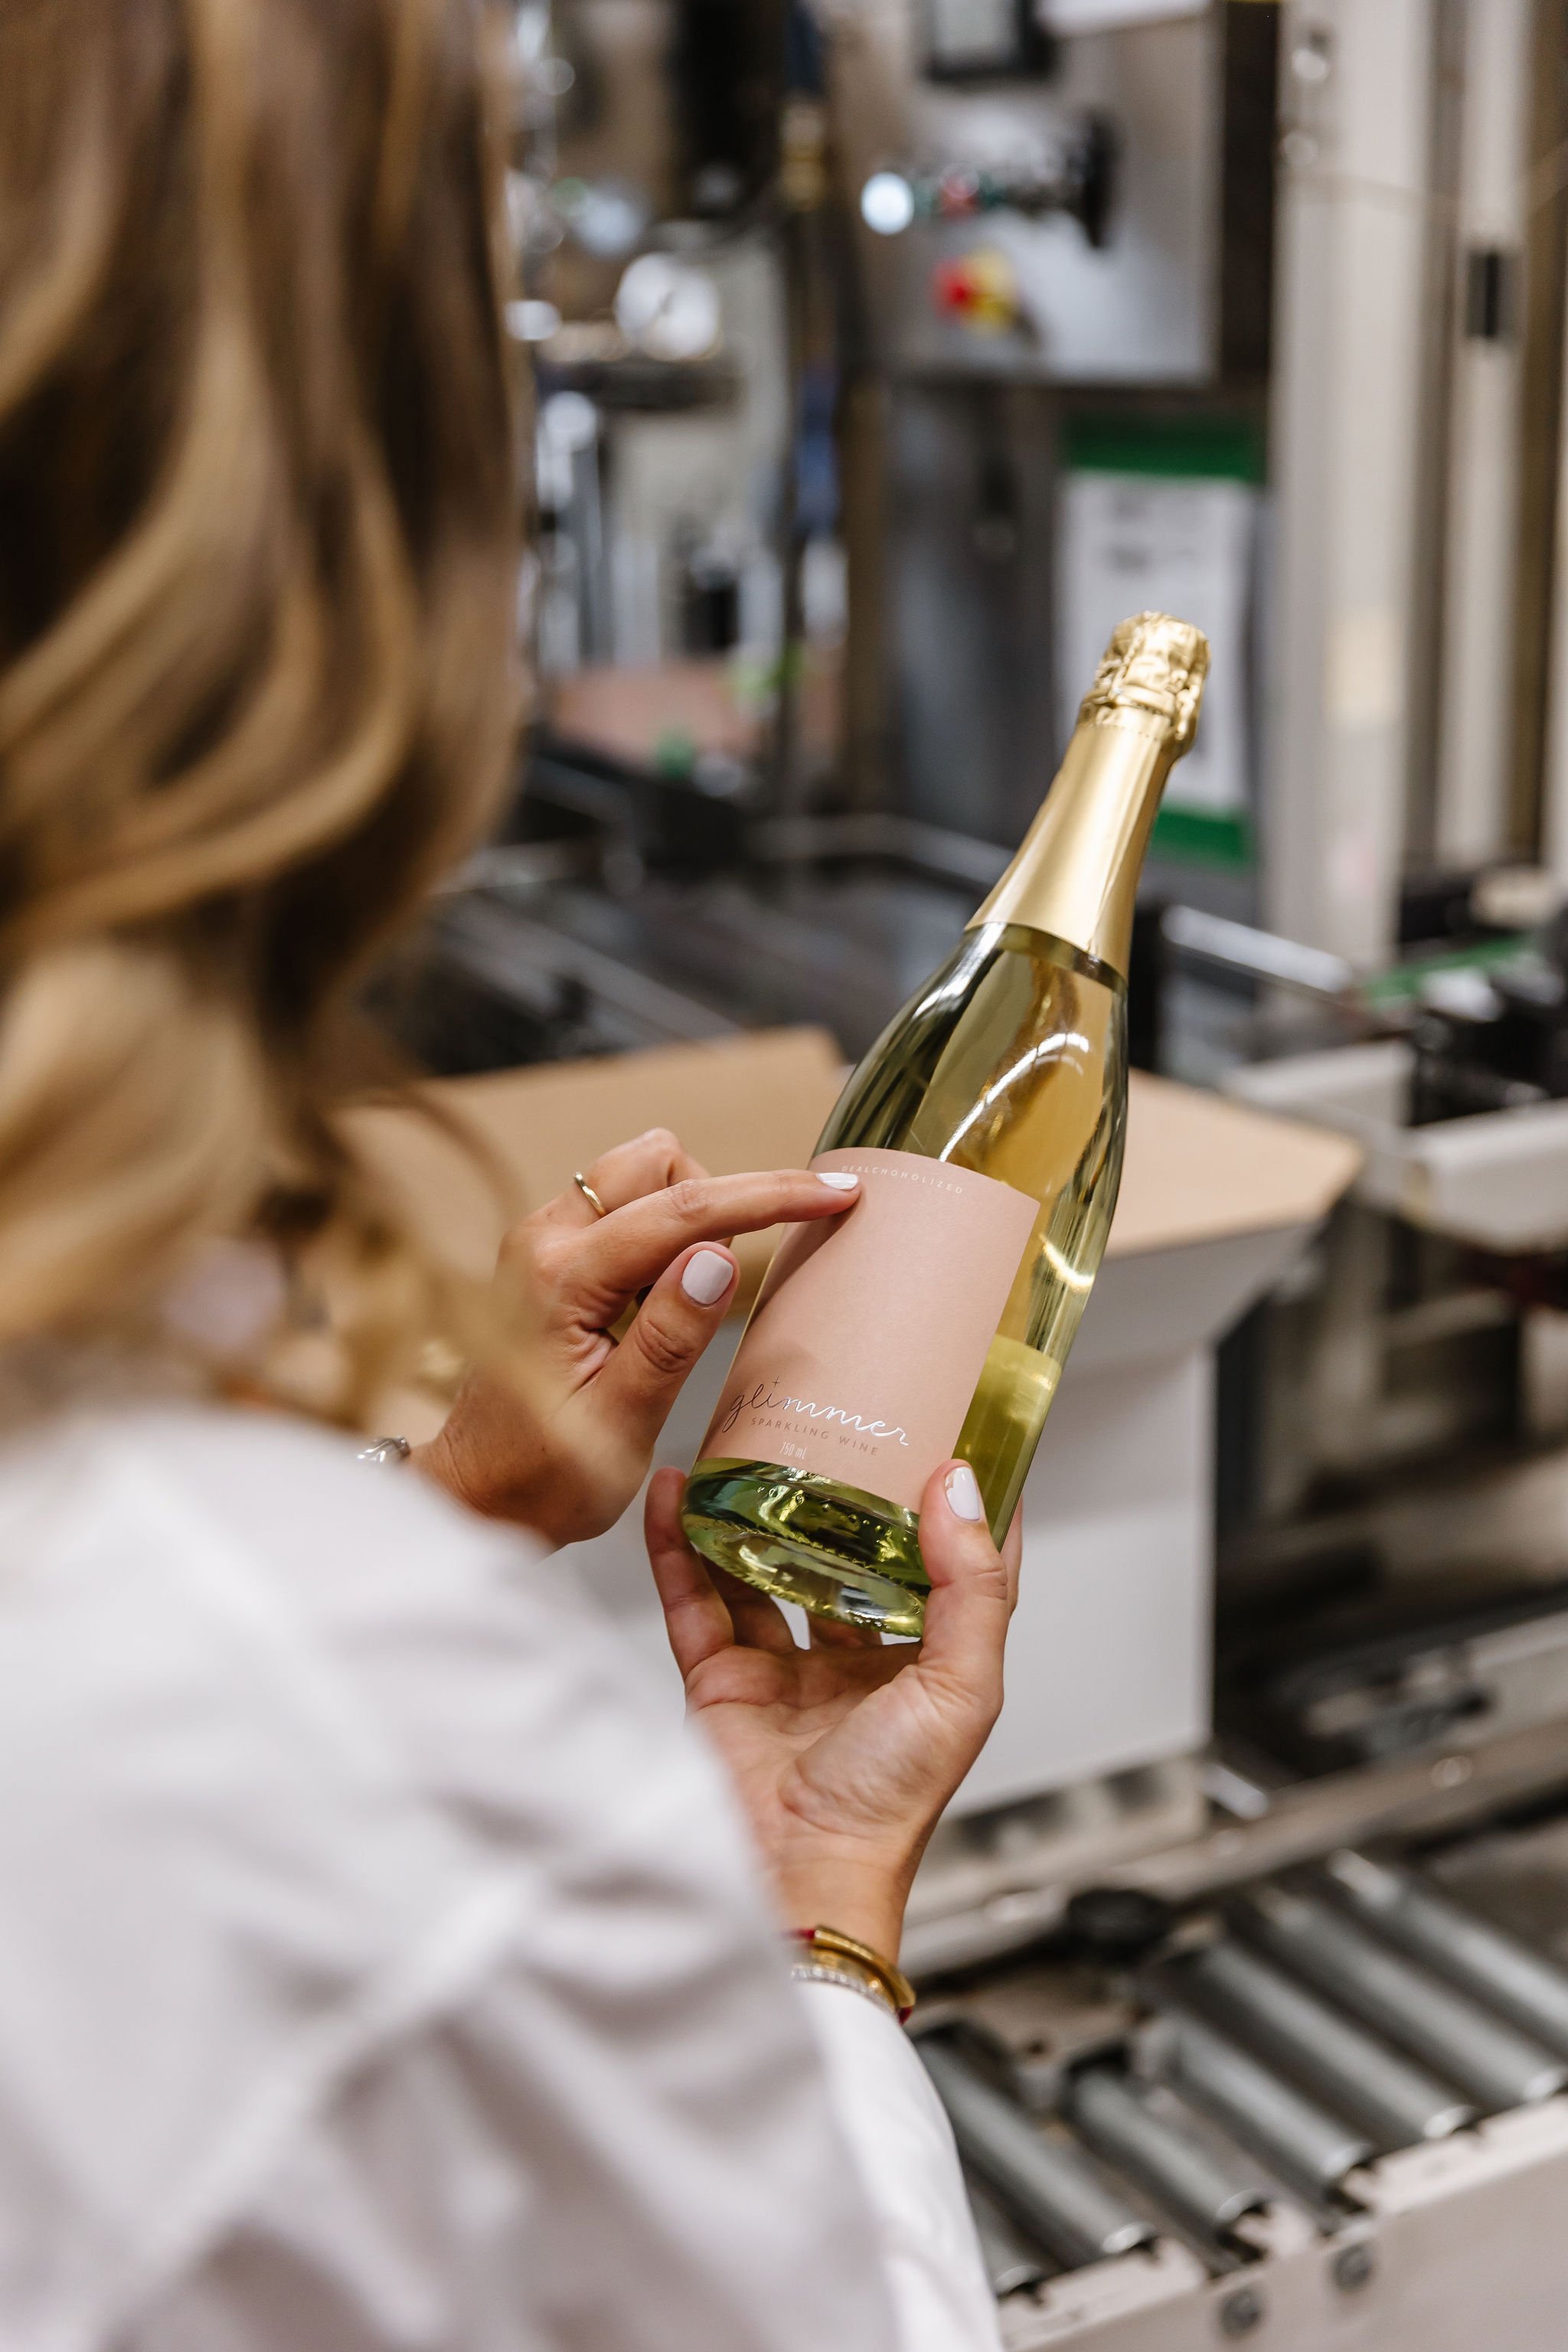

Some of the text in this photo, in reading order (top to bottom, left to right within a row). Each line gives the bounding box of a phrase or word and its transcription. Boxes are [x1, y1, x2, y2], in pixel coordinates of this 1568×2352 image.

[722, 1377, 909, 1446] glimmer
[750, 1416, 879, 1456] SPARKLING WINE
[779, 1442, 794, 1456] 750
